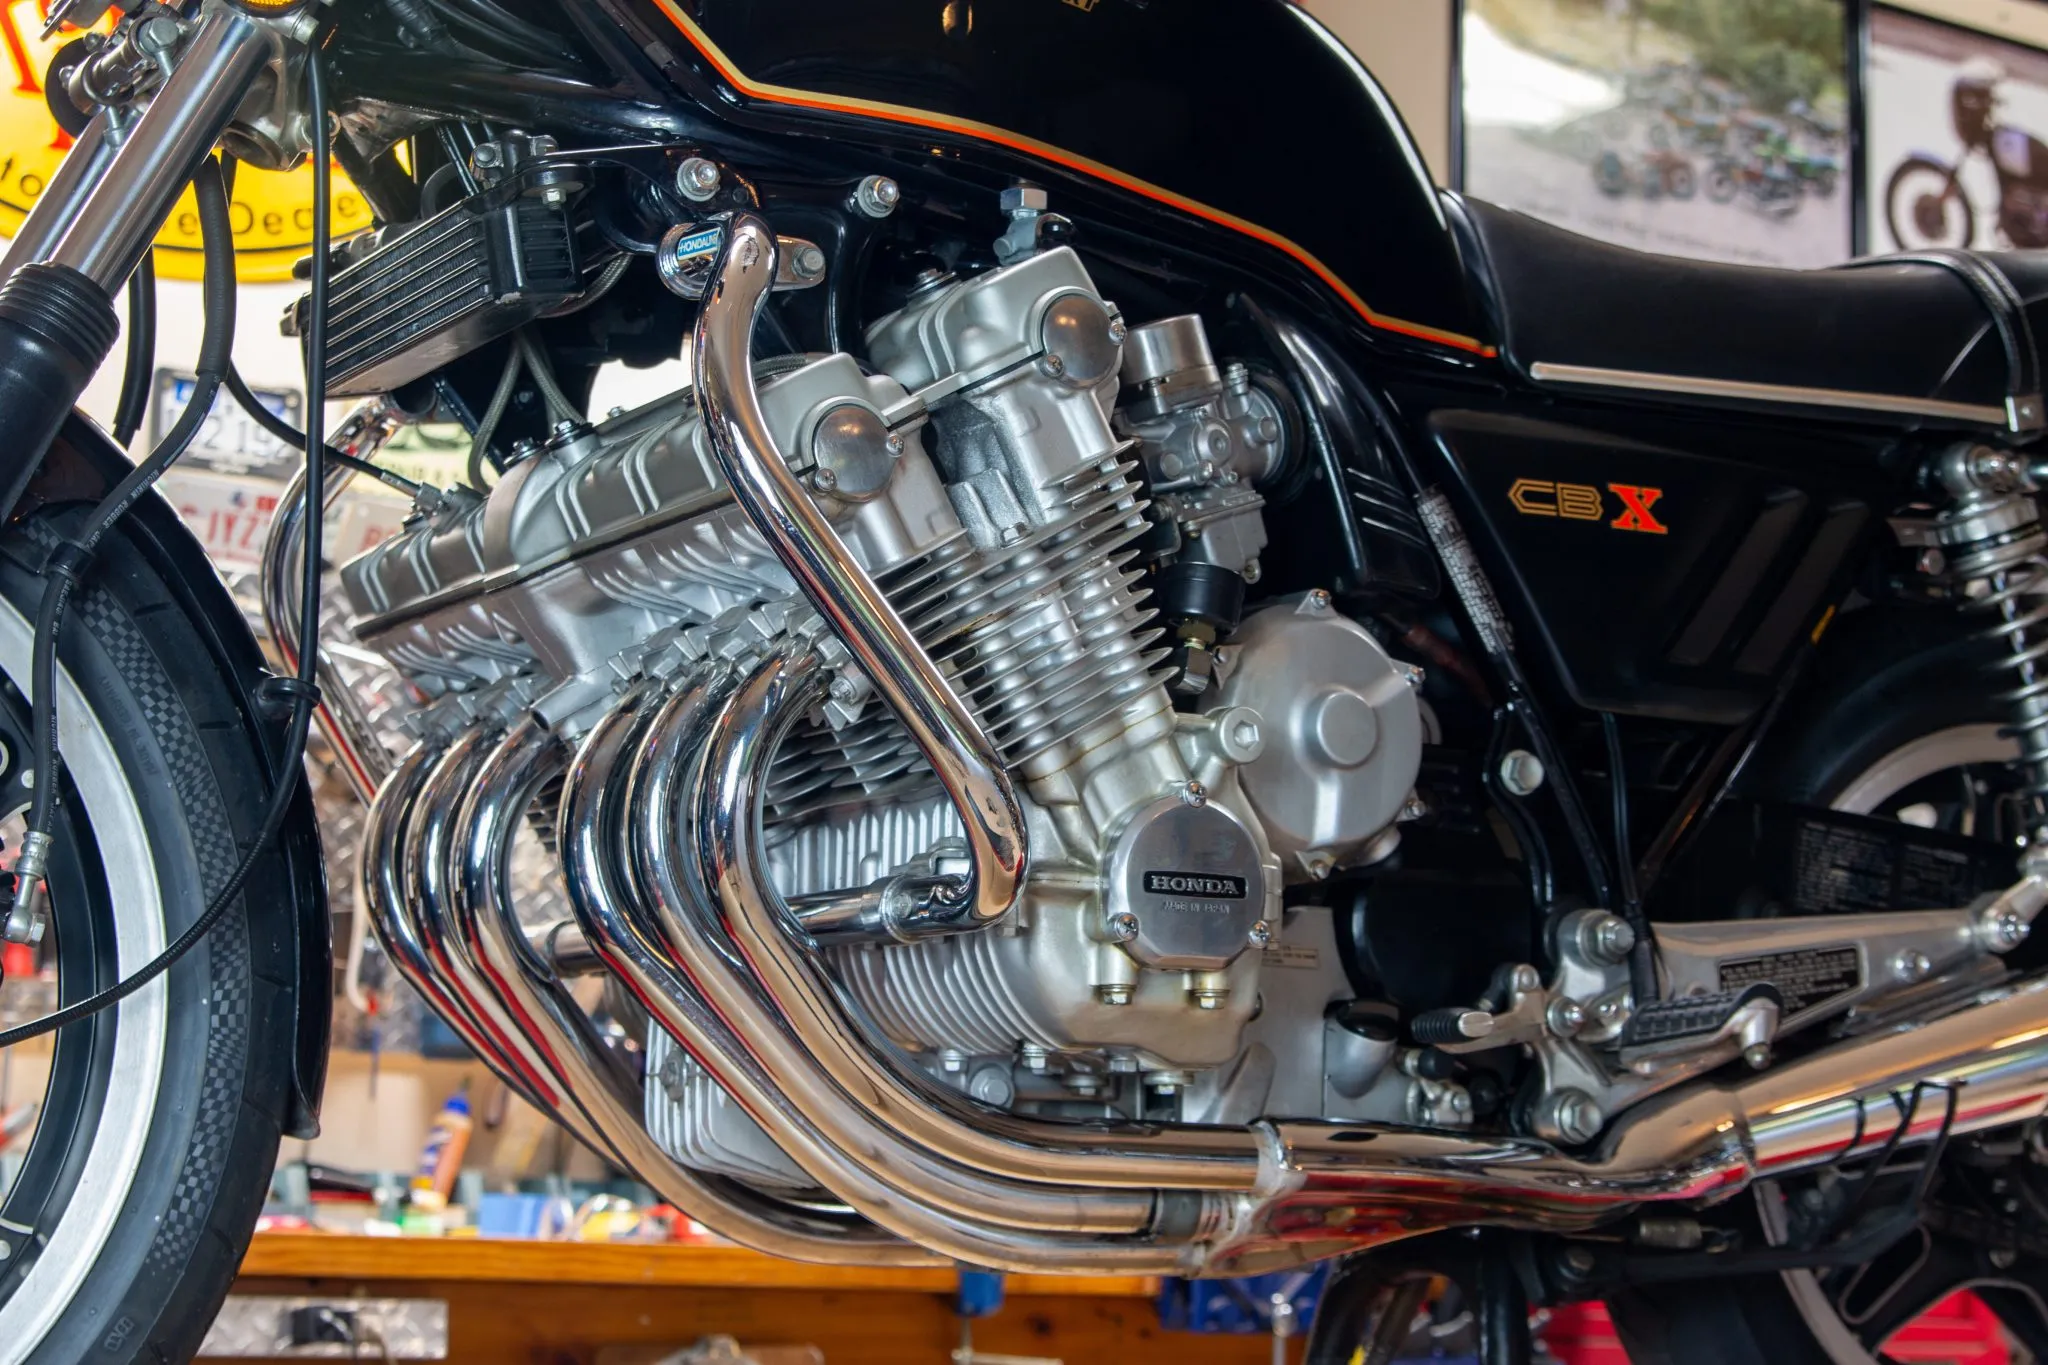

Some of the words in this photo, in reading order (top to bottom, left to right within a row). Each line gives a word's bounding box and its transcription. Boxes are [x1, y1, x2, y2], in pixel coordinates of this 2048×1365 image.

[103, 499, 129, 528] RUBBER
[1508, 478, 1668, 534] CBX
[1151, 875, 1239, 895] HONDA
[1164, 901, 1188, 912] MADE
[1191, 902, 1200, 912] IN
[1204, 903, 1230, 914] JAPAN
